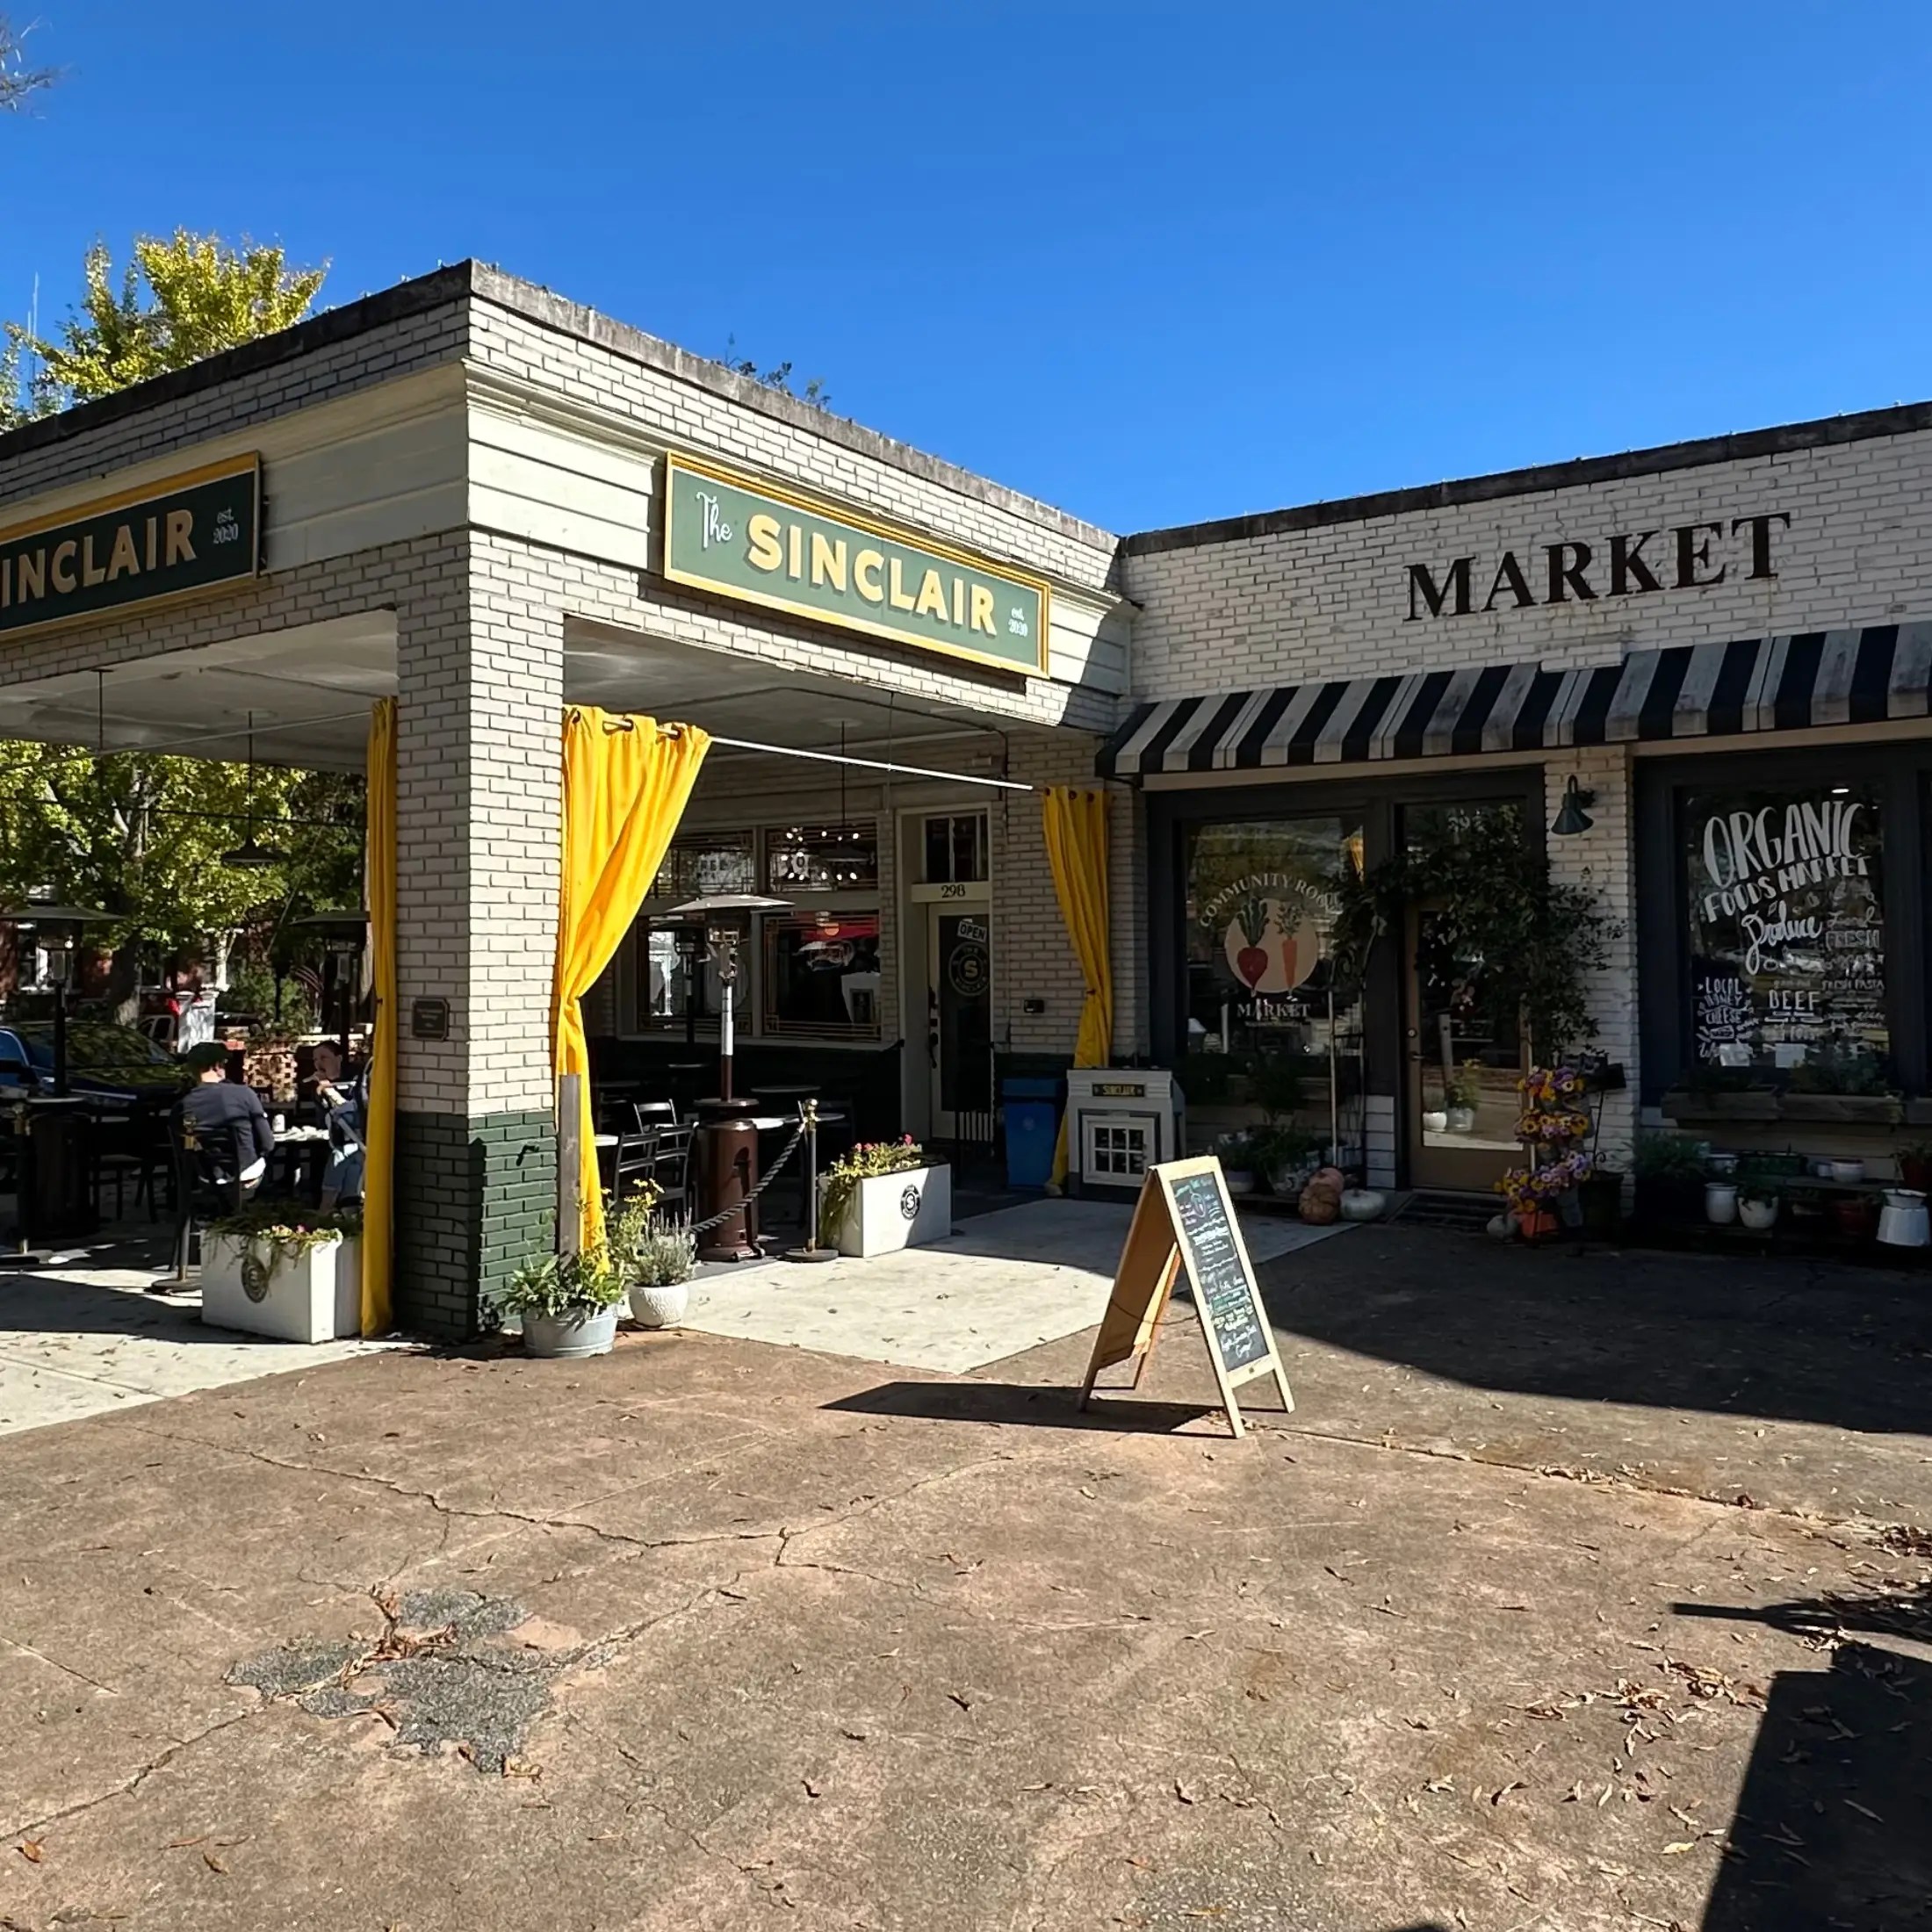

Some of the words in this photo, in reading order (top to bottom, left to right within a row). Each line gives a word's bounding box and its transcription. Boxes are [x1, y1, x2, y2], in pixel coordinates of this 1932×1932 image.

[213, 523, 239, 544] 2020
[695, 491, 733, 549] The
[747, 514, 998, 636] SINCLAIR
[1402, 512, 1791, 622] MARKET
[1703, 800, 1866, 889] ORGANIC
[941, 884, 966, 898] 298
[1200, 872, 1291, 927] COMMUNITY
[1704, 876, 1777, 923] FOODS
[1777, 855, 1872, 893] MARKET
[960, 924, 985, 941] OPEN
[1741, 900, 1822, 975] Produce
[963, 960, 979, 979] S
[1705, 977, 1743, 995] LOCAL
[1236, 1002, 1312, 1018] MARKET
[1769, 989, 1821, 1012] BEEF
